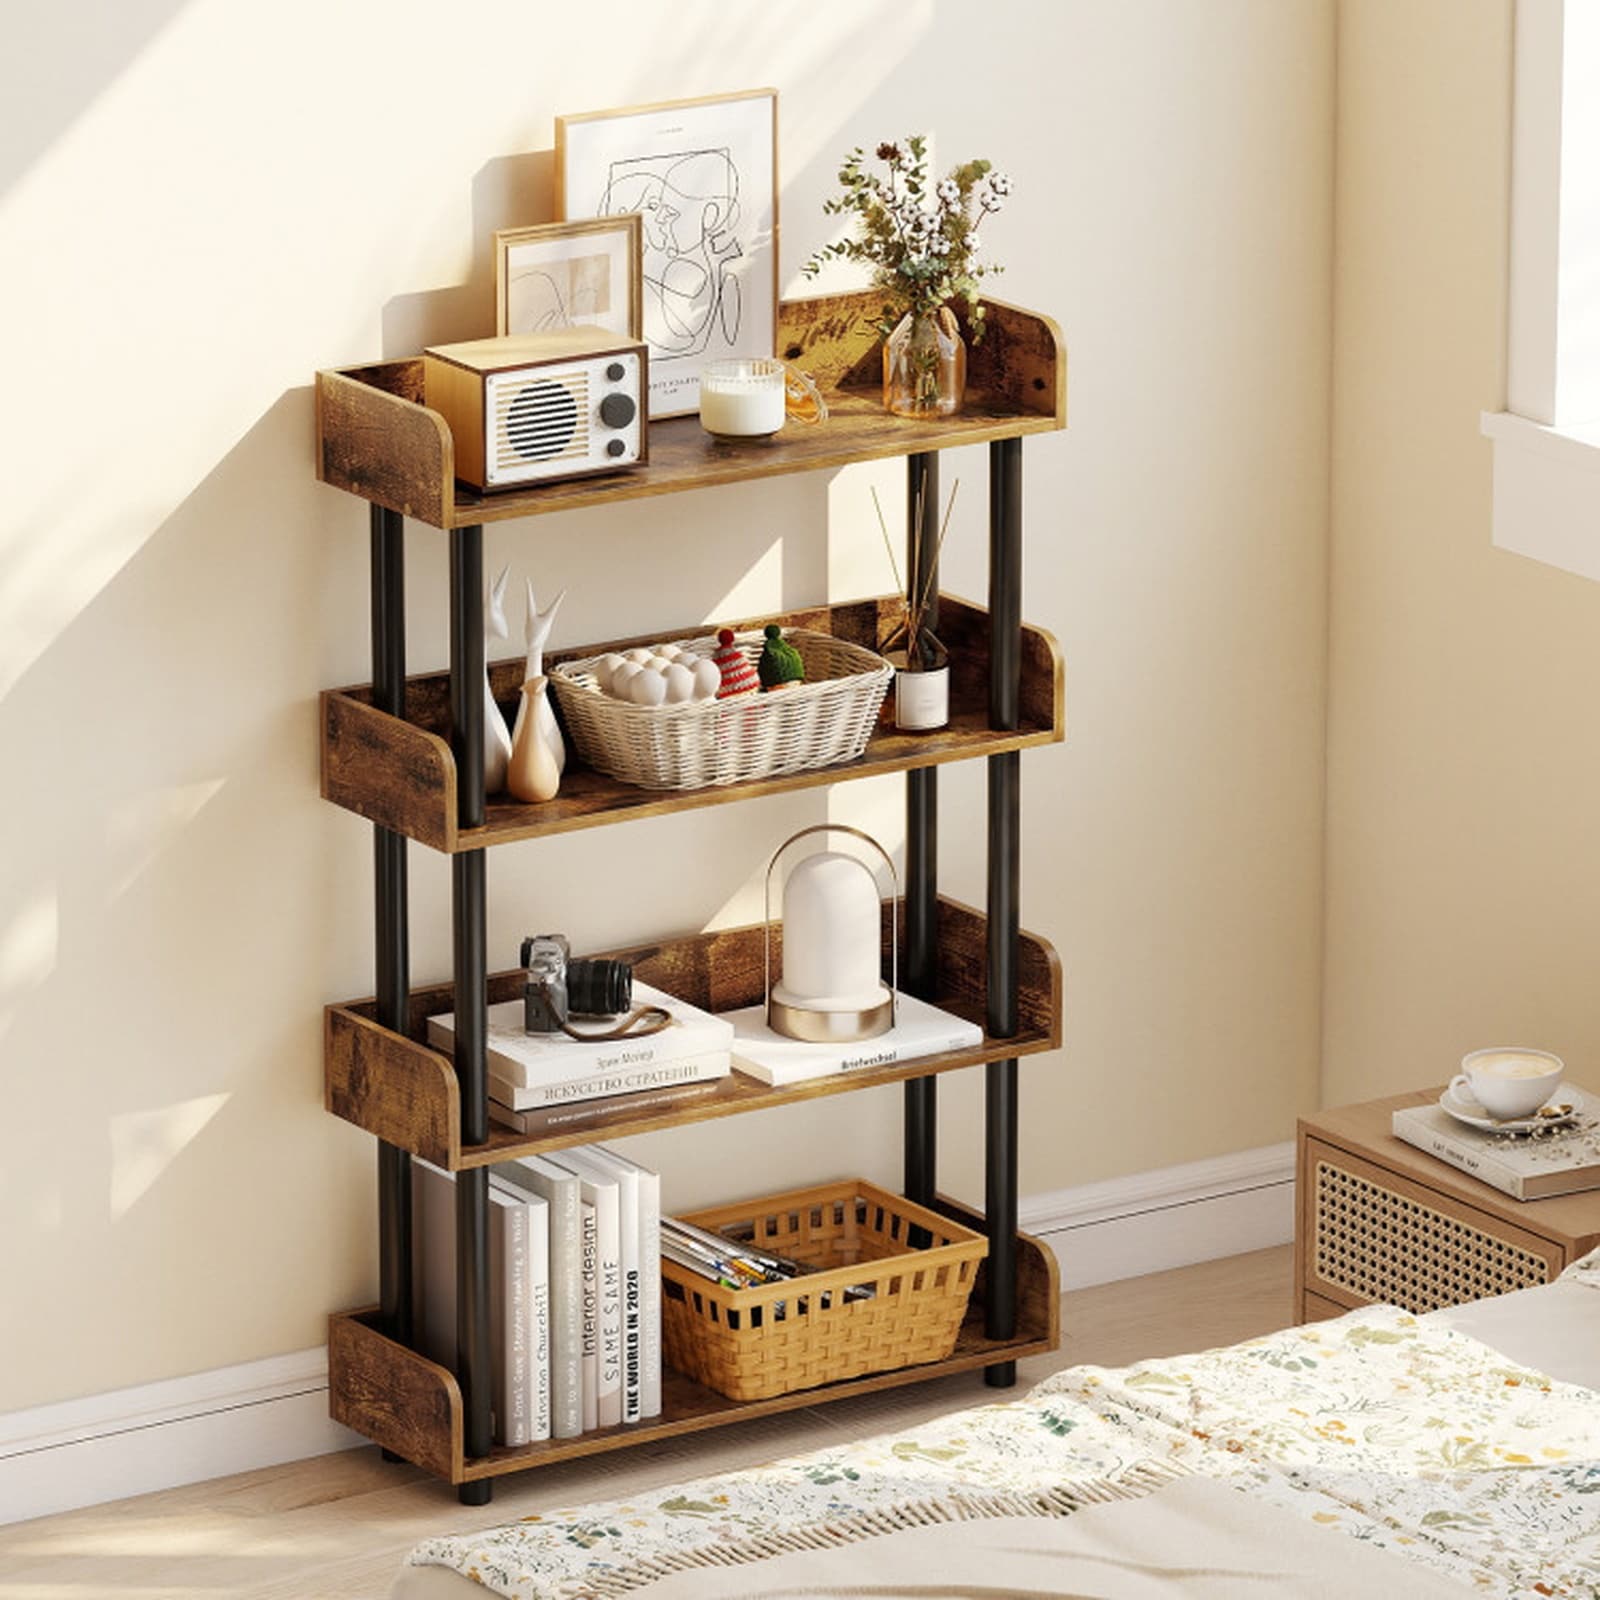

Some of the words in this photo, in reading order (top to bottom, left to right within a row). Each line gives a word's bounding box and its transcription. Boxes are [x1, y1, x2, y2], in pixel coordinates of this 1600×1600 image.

[544, 1077, 621, 1100] ИСКУССТВО
[624, 1065, 699, 1088] СТРАТЕГИИ
[581, 1216, 597, 1282] design
[603, 1260, 619, 1315] SAME
[626, 1270, 638, 1311] 2020
[534, 1283, 547, 1362] Churchill
[581, 1287, 596, 1358] Interior
[627, 1314, 638, 1329] IN
[603, 1325, 619, 1381] SAME
[627, 1333, 638, 1388] WORLD
[536, 1368, 547, 1432] Winston
[627, 1390, 638, 1418] THE
